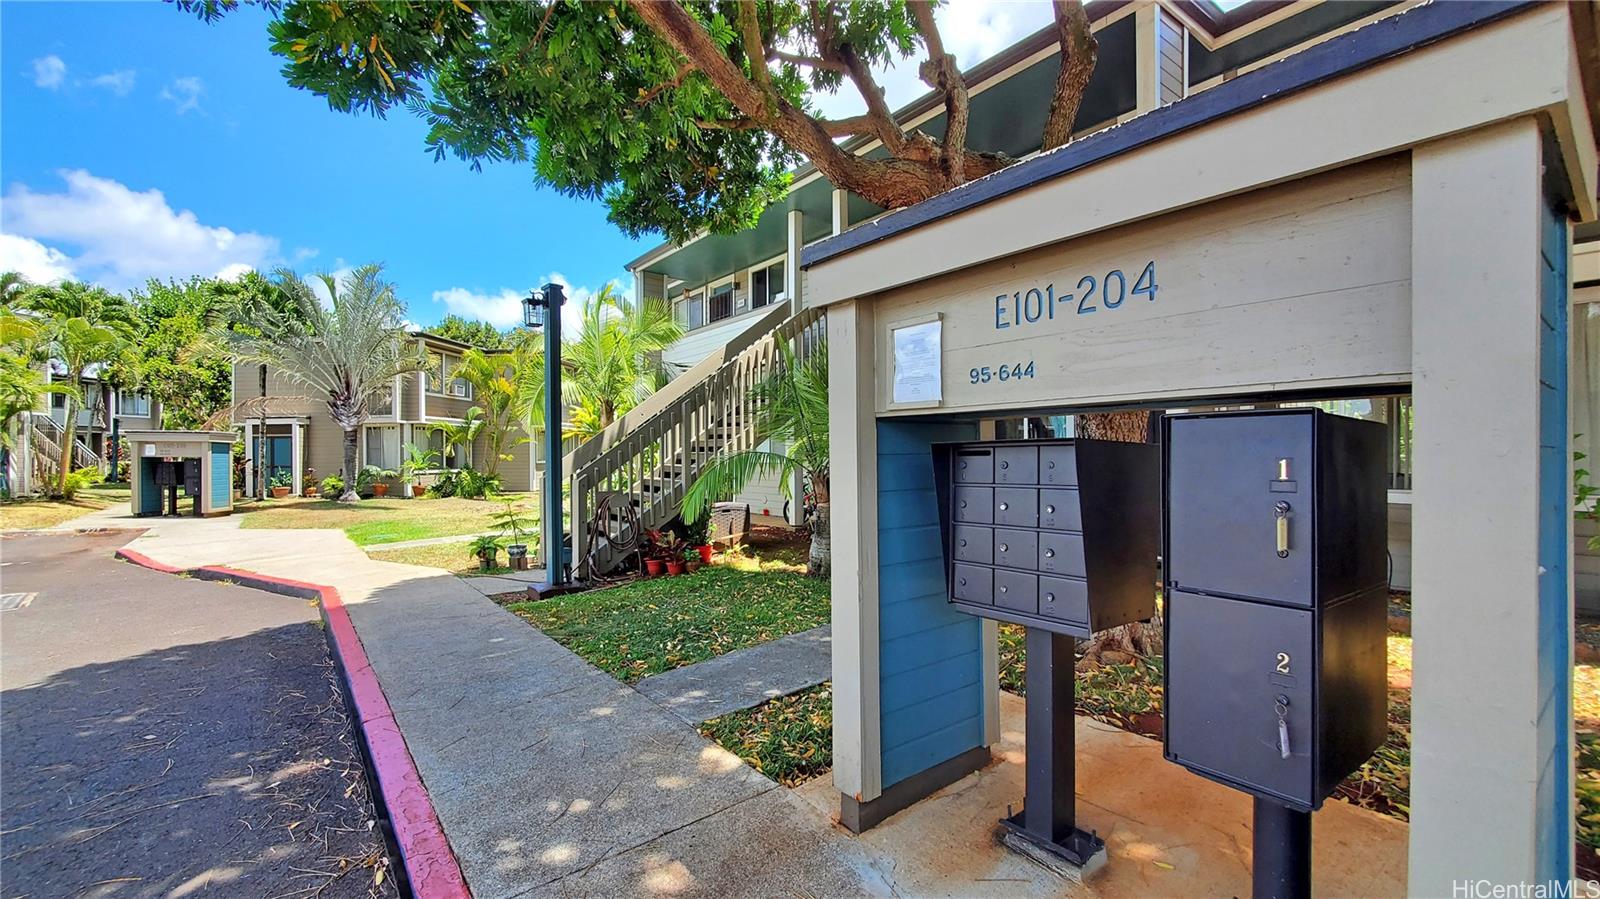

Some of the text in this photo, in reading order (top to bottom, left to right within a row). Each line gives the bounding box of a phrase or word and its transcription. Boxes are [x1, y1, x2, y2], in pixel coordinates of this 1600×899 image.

[995, 260, 1158, 329] E101-204
[1278, 459, 1288, 480] 1
[1276, 652, 1289, 673] 2
